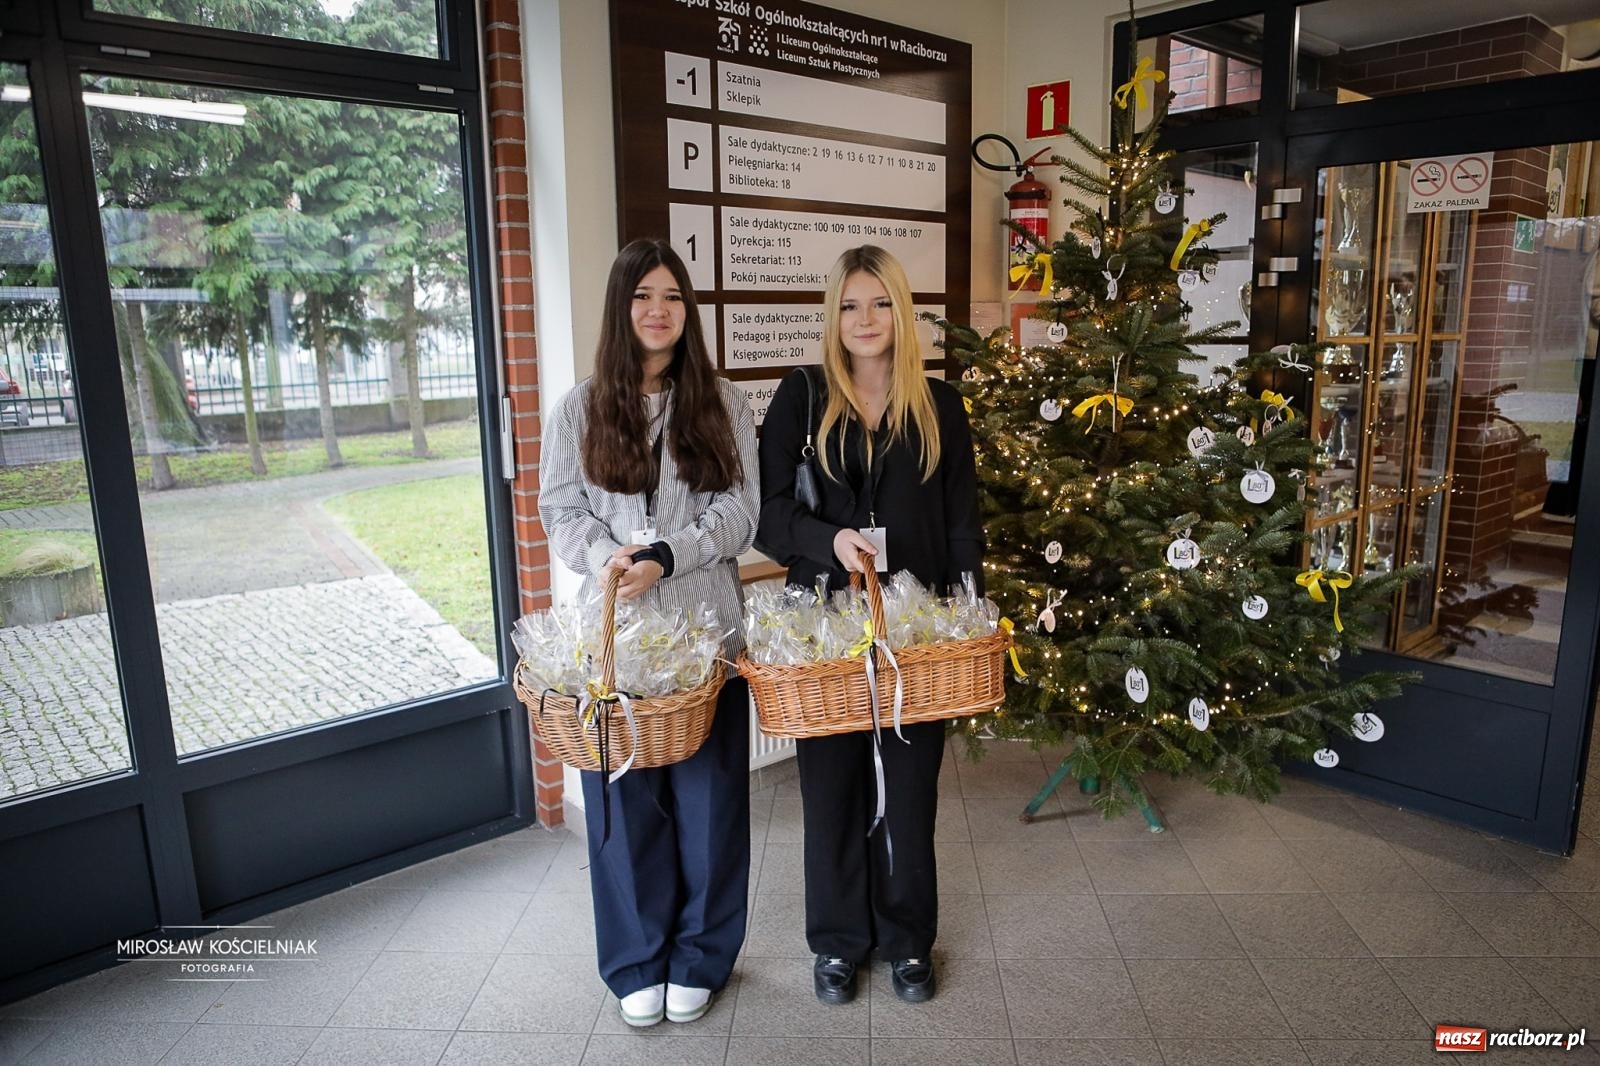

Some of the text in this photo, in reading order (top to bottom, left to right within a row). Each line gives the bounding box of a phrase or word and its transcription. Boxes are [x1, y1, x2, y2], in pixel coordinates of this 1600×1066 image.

[715, 0, 751, 17] Szkół
[755, 6, 868, 44] Ogólnokształcących
[890, 40, 899, 51] w
[900, 39, 947, 62] Raciborzu
[781, 33, 811, 49] Liceum
[812, 41, 878, 64] Ogólnokształcące
[777, 49, 880, 80] Liceum Sztuk Plastycznych
[676, 67, 697, 96] -1
[726, 71, 761, 87] Szatnia
[726, 90, 761, 107] Sklepik
[684, 141, 699, 170] P
[727, 135, 936, 172] Sale dydaktyczne: 2 19 16 13 6 12 7 11 10 8 21 20
[728, 154, 801, 173] Pielęgniarka: 14
[729, 173, 791, 190] Biblioteka: 18
[1414, 198, 1480, 208] ZAKAZ PALENIA
[730, 216, 922, 238] Sale dydaktyczne: 100 109 103 104 106 108 107
[687, 234, 696, 261] 1
[730, 234, 791, 249] Dyrekcja: 115
[730, 253, 802, 266] Sekretariat: 113
[731, 271, 757, 285] Pokój
[760, 273, 821, 286] nauczycielski:
[732, 313, 752, 324] Sale
[754, 313, 813, 326] dydaktyczne:
[733, 329, 823, 344] Pedagog i psycholog:
[733, 347, 804, 362] Księgowość: 201
